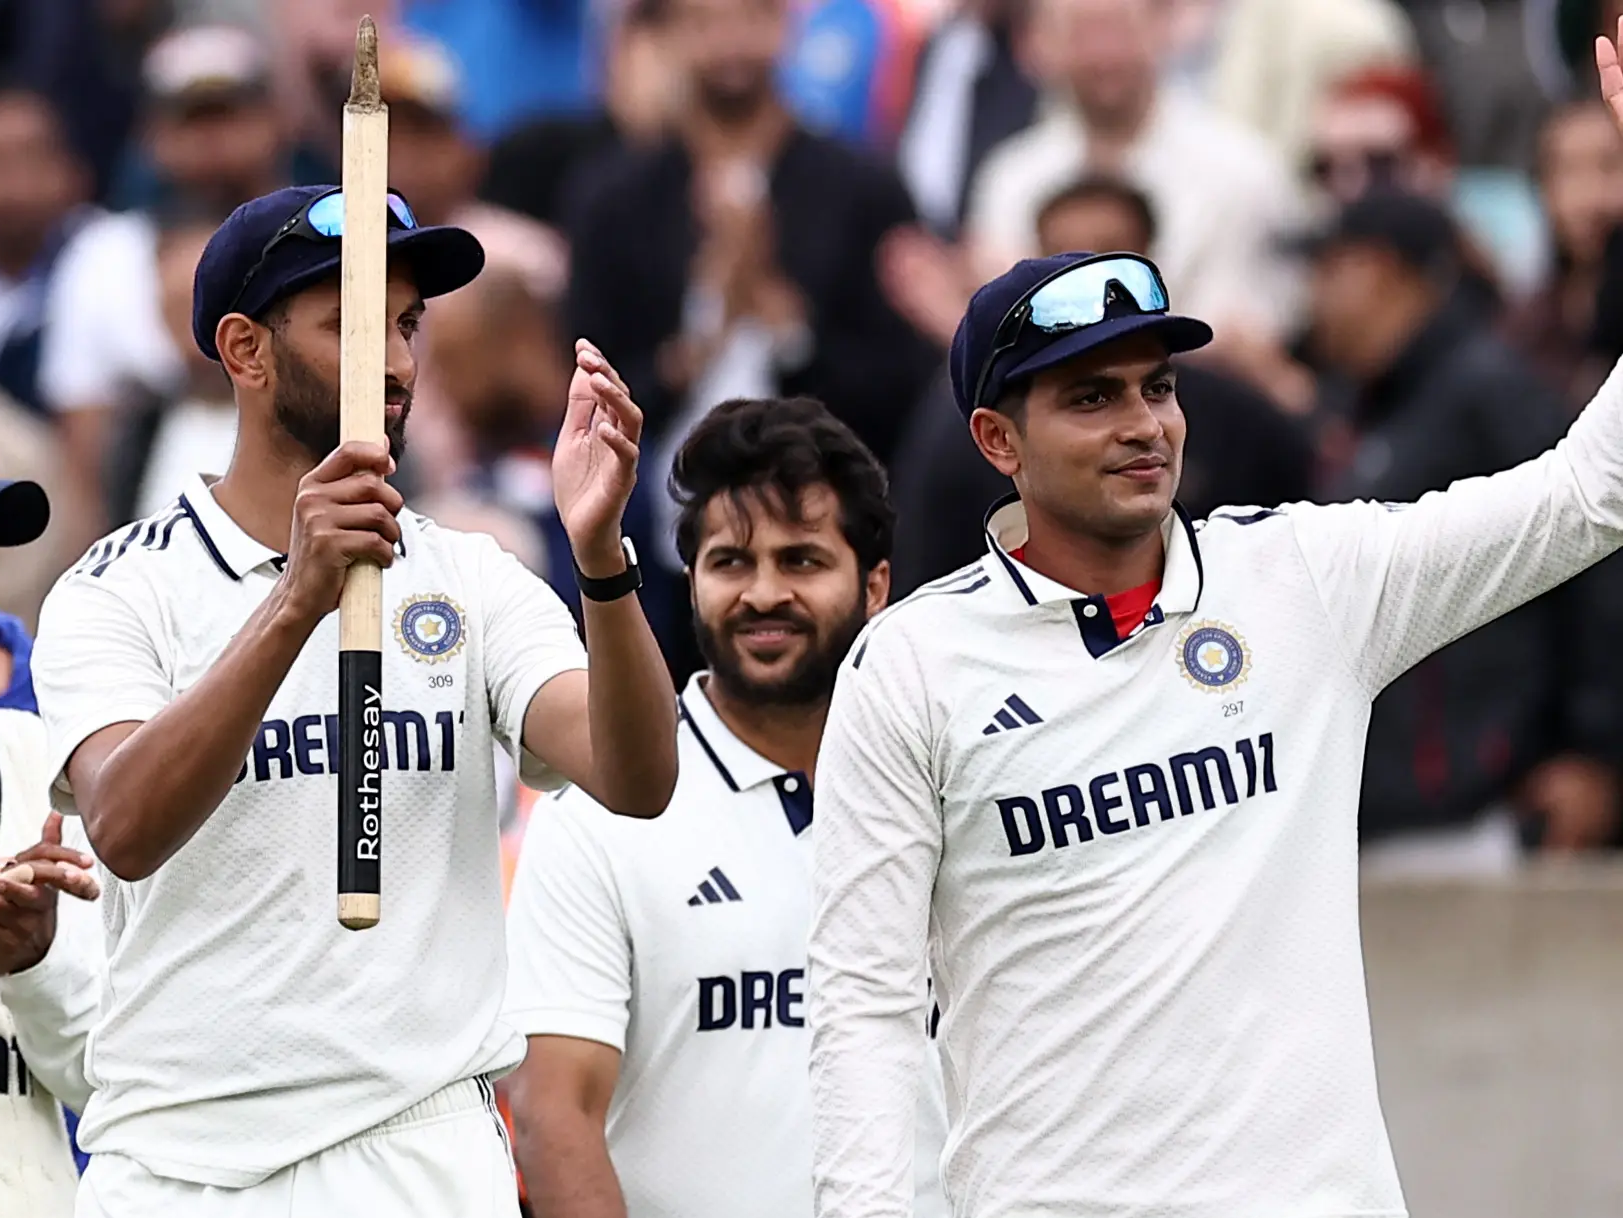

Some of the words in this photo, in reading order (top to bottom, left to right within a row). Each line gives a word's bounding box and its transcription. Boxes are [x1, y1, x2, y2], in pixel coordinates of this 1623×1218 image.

[427, 674, 454, 689] 309
[1221, 700, 1245, 718] 297
[356, 683, 382, 860] Rothesay
[994, 731, 1278, 858] DREAM11
